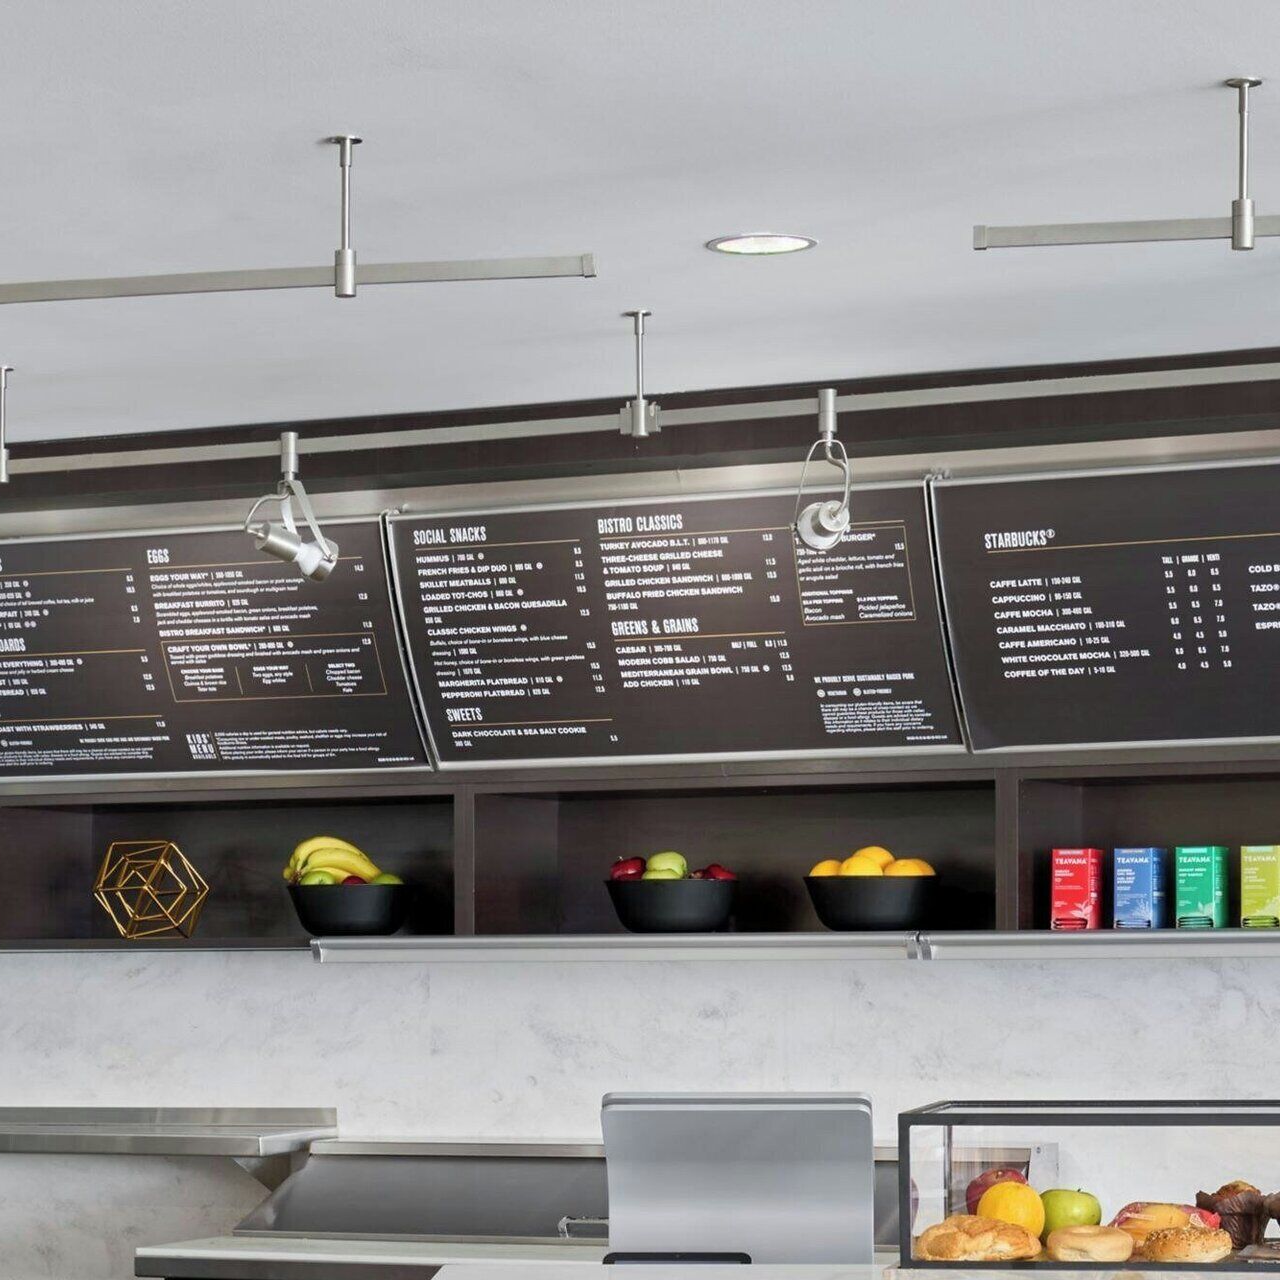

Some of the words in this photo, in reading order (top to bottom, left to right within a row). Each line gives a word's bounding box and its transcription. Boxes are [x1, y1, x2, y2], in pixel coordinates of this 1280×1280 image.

[598, 518, 633, 534] BISTRO
[636, 515, 683, 532] CLASSICS
[413, 528, 447, 545] SOCIAL
[449, 526, 487, 543] SNACKS
[600, 541, 630, 551] TURKEY
[630, 539, 669, 550] AVOCADO
[670, 537, 691, 547] B.L.T.
[146, 549, 170, 564] EGGS
[416, 554, 450, 564] HUMMUS
[601, 553, 658, 565] THREE-CHEESE
[659, 551, 691, 562] GRILLED
[692, 549, 723, 559] CHEESE
[418, 567, 447, 576] FRENCH
[448, 567, 469, 575] FRIES
[477, 566, 490, 574] DIP
[491, 564, 508, 572] DUO
[603, 567, 609, 575] &
[609, 564, 642, 574] TOMATO
[643, 563, 664, 573] SOUP
[1248, 564, 1273, 574] COLD
[419, 580, 448, 589] SKILLET
[449, 578, 492, 587] MEATBALLS
[604, 578, 636, 588] GRILLED
[637, 576, 671, 586] CHICKEN
[672, 574, 714, 584] SANDWICH
[989, 580, 1016, 589] CAFFE
[1017, 578, 1043, 587] LATTE
[421, 593, 451, 601] LOADED
[451, 590, 488, 600] TOT-CHOS
[606, 591, 641, 601] BUFFALO
[642, 589, 665, 599] FRIED
[666, 587, 700, 598] CHICKEN
[701, 585, 743, 596] SANDWICH
[992, 594, 1046, 604] CAPPUCCINO
[423, 604, 453, 614] GRILLED
[454, 603, 485, 612] CHICKEN
[486, 603, 493, 611] &
[494, 601, 521, 610] BACON
[522, 600, 567, 609] QUESADILLA
[994, 610, 1021, 619] CAFFE
[1022, 609, 1053, 618] MOCHA
[427, 627, 458, 636] CLASSIC
[458, 626, 491, 635] CHICKEN
[491, 625, 517, 634] WINGS
[611, 621, 647, 637] GREENS
[651, 621, 661, 635] &
[663, 618, 699, 634] GRAINS
[996, 625, 1036, 634] CARAMEL
[1037, 622, 1086, 633] MACCHIATO
[615, 645, 646, 654] CAESAR
[998, 640, 1026, 649] CAFFE
[1026, 638, 1077, 648] AMERICANO
[618, 657, 651, 667] MODERN
[652, 655, 674, 666] COBB
[675, 654, 700, 664] SALAD
[1001, 655, 1027, 664] WHITE
[1028, 653, 1078, 663] CHOCOLATE
[1079, 651, 1111, 661] MOCHA
[620, 668, 684, 679] MEDITERRANEAN
[685, 668, 708, 676] GRAIN
[709, 666, 734, 676] BOWL
[1004, 670, 1037, 679] COFFEE
[1050, 669, 1066, 677] THE
[1067, 667, 1085, 676] DAY
[438, 678, 486, 687] MARGHERITA
[486, 677, 528, 686] FLATBREAD
[623, 680, 640, 689] ADD
[640, 678, 674, 688] CHICKEN
[441, 691, 483, 699] PEPPERONI
[483, 689, 525, 697] FLATBREAD
[446, 708, 483, 721] SWEETS
[452, 730, 473, 738] DARK
[473, 728, 517, 737] CHOCOLATE
[517, 728, 523, 736] &
[523, 727, 539, 736] SEA
[539, 727, 557, 735] SALT
[558, 725, 586, 734] COOKIE
[1055, 857, 1087, 865] TEAVANA
[1116, 856, 1149, 864] TEAVANA
[1178, 856, 1211, 864] TEAVANA
